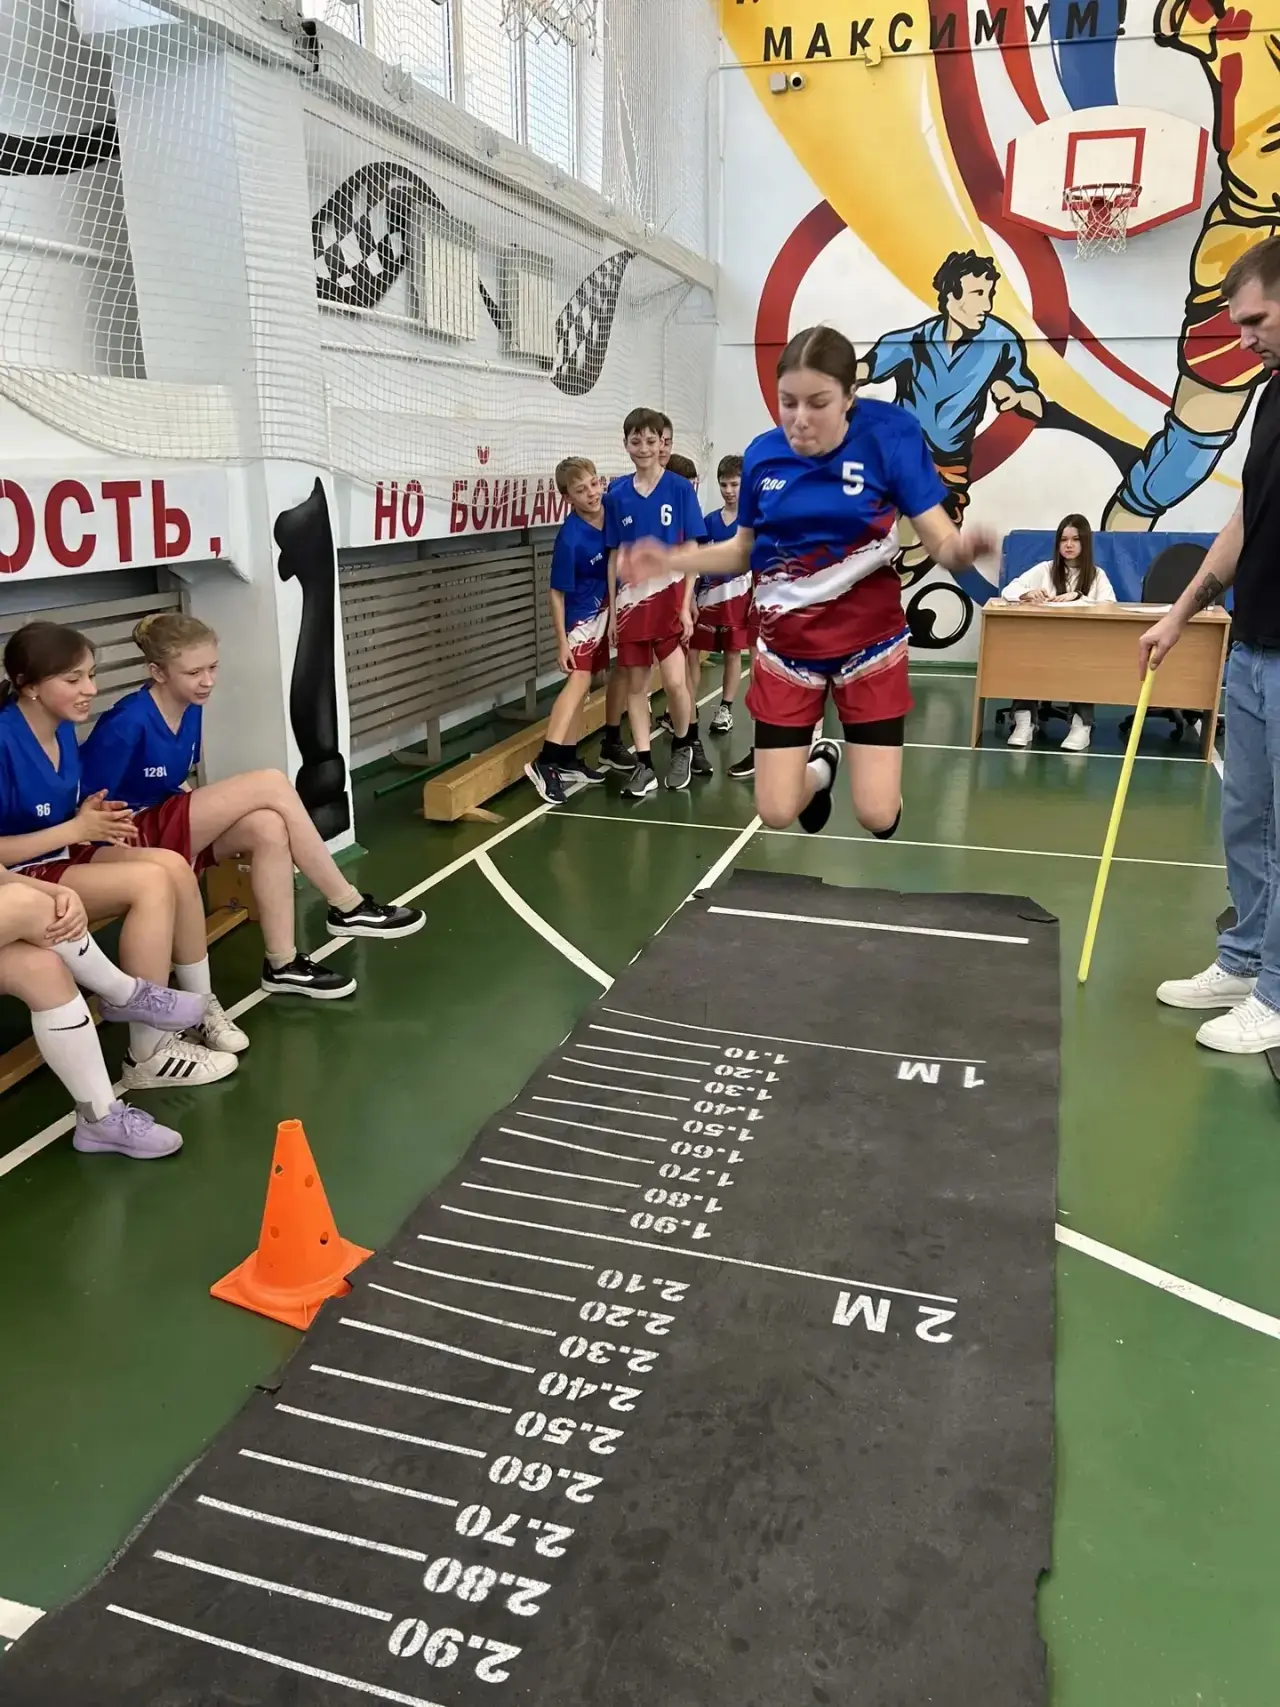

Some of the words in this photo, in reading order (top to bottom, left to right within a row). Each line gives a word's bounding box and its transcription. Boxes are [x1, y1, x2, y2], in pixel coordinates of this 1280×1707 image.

[763, 0, 1127, 62] МАКСИМУМ!
[842, 461, 865, 496] 5
[374, 478, 424, 541] НО
[660, 503, 673, 526] 6
[723, 1047, 790, 1065] 1.10
[714, 1064, 780, 1083] 1.20
[962, 1065, 985, 1089] 1
[704, 1081, 773, 1101] 1.30
[693, 1100, 764, 1121] 1.40
[682, 1119, 755, 1142] 1.50
[670, 1140, 745, 1164] 1.60
[658, 1163, 735, 1187] 1.70
[643, 1187, 723, 1213] 1.80
[629, 1212, 712, 1240] 1.90
[596, 1269, 691, 1302] 2.10
[579, 1300, 676, 1335] 2.20
[915, 1304, 957, 1344] 2
[558, 1335, 660, 1373] 2.30
[538, 1371, 643, 1412] 2.40
[514, 1410, 625, 1455] 2.50
[488, 1455, 604, 1504] 2.60
[455, 1504, 576, 1558] 2.70
[423, 1557, 552, 1617] 2.80
[388, 1617, 523, 1684] 2.90
